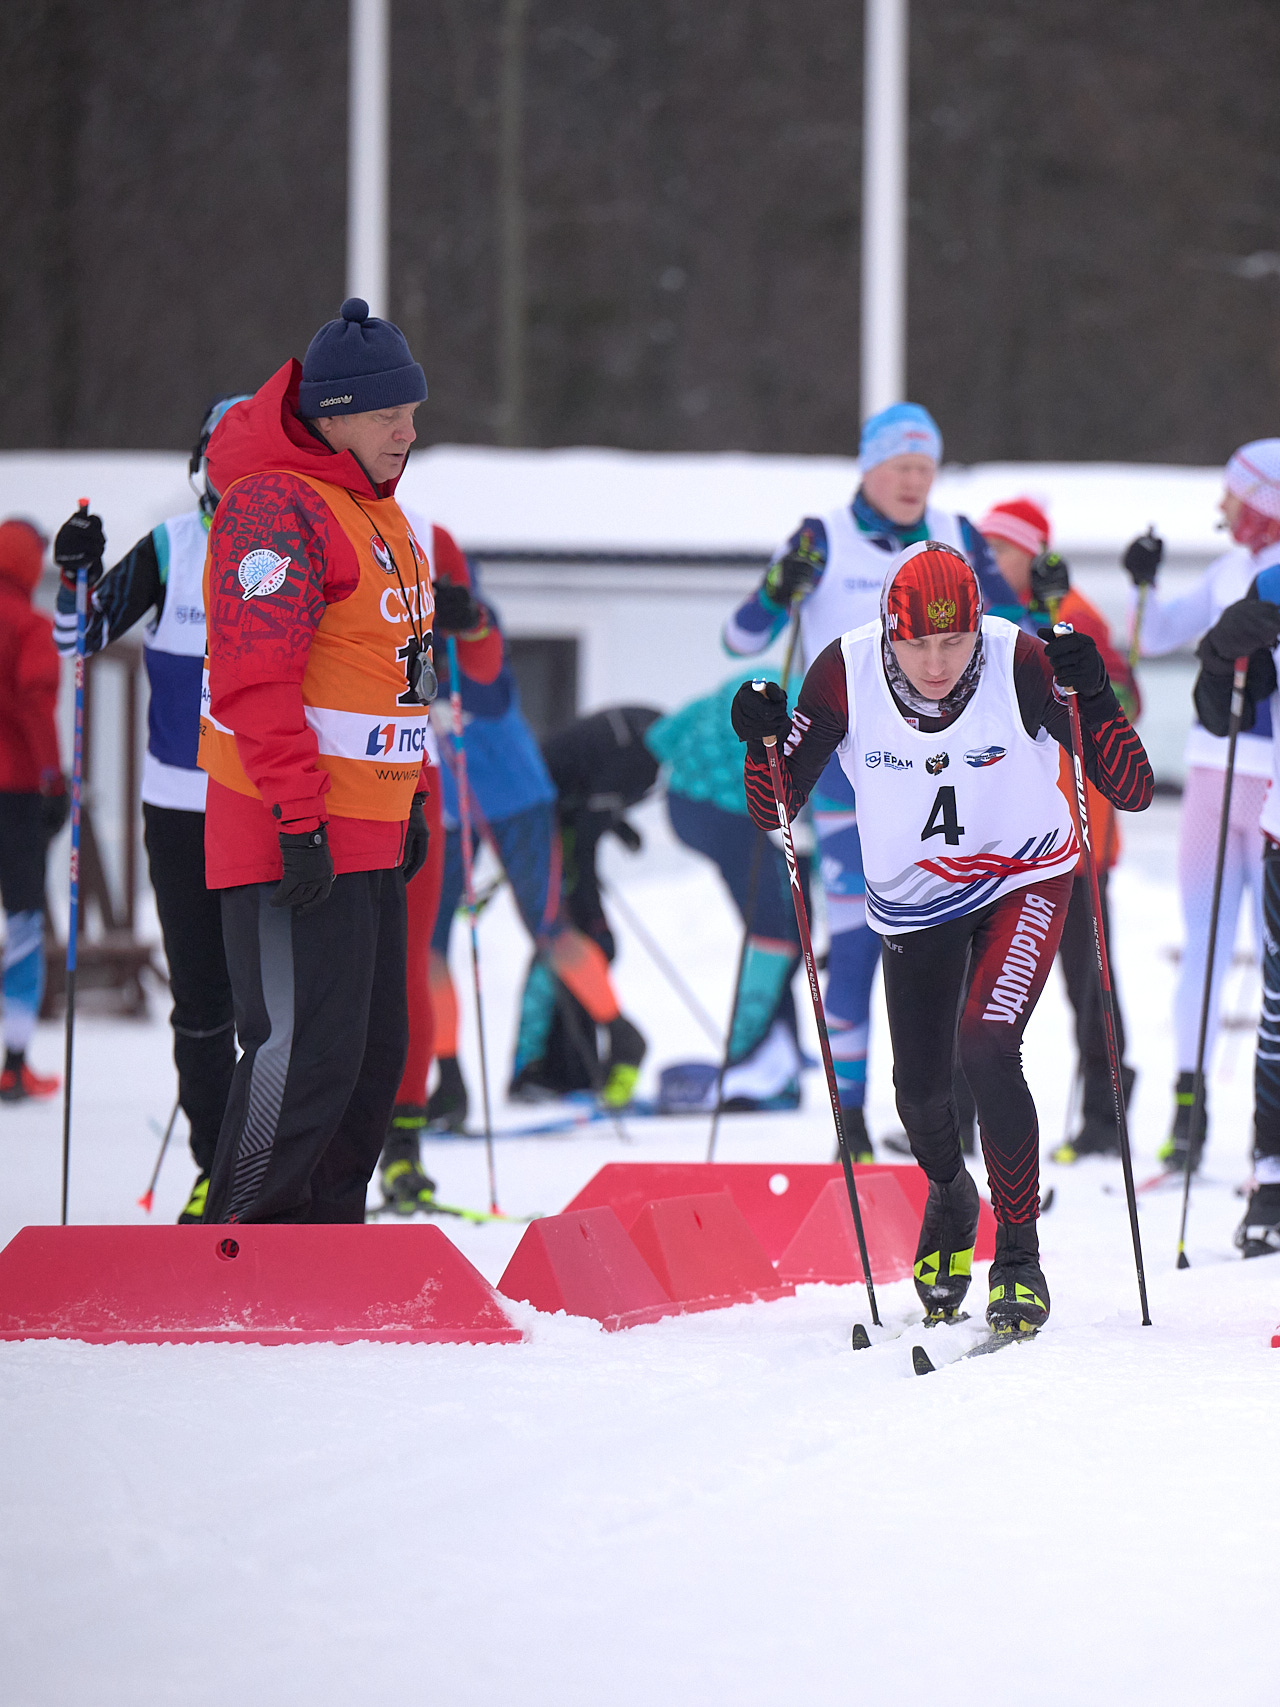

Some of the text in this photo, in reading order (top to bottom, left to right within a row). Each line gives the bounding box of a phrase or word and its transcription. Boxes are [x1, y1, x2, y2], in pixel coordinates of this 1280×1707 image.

[319, 397, 341, 408] adidas
[920, 785, 966, 846] 4
[805, 952, 814, 973] TRIAC
[811, 981, 819, 1002] AERO
[982, 893, 1057, 1025] УДМУРТИЯ
